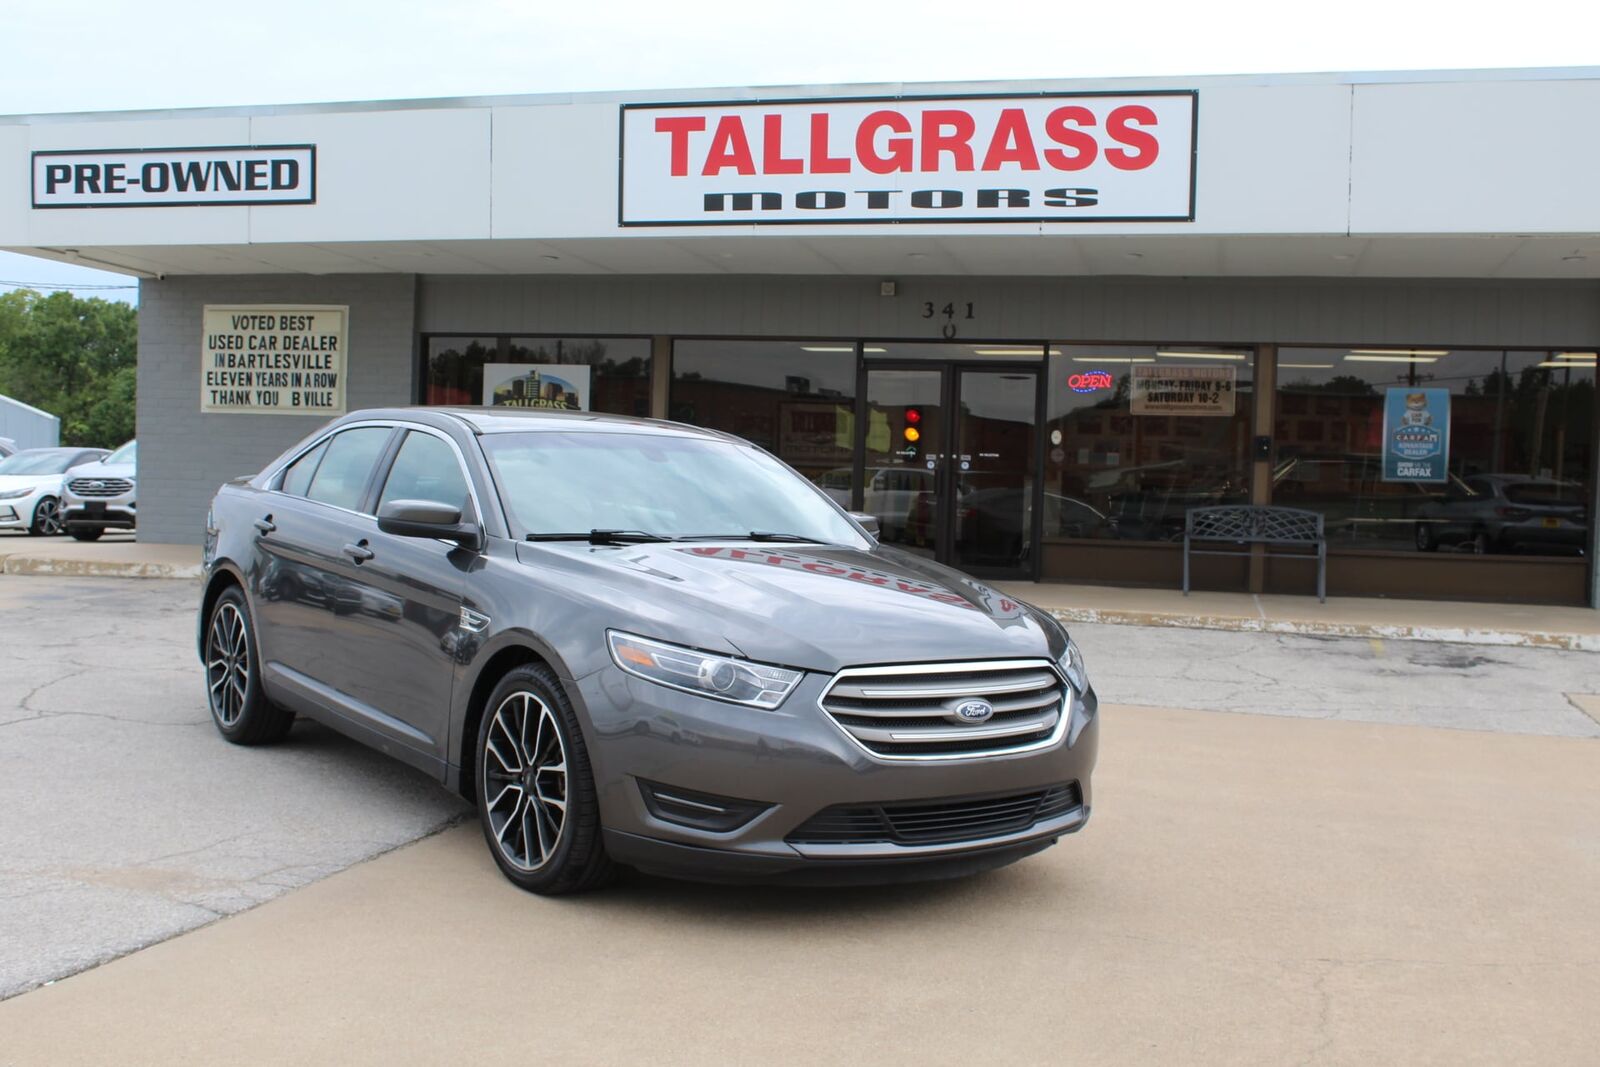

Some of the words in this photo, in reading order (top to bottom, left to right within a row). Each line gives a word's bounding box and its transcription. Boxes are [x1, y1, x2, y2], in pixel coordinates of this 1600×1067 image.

[654, 104, 1160, 176] TALLGRASS
[45, 158, 299, 194] PRE-OWNED
[232, 315, 275, 331] VOTED
[280, 315, 315, 331] BEST
[209, 335, 243, 350] USED
[248, 335, 277, 350] CAR
[283, 336, 337, 351] DEALER
[215, 353, 225, 367] IN
[228, 354, 332, 369] BARTLESVILLE
[207, 371, 252, 386] ELEVEN
[256, 372, 288, 387] YEARS
[291, 373, 302, 387] IN
[305, 373, 311, 388] A
[314, 373, 337, 388] ROW
[1067, 374, 1112, 389] OPEN
[211, 390, 251, 405] THANK
[256, 390, 279, 406] YOU
[292, 391, 300, 406] B
[304, 391, 333, 407] VILLE
[1147, 392, 1194, 403] SATURDAY
[1397, 468, 1432, 477] CARFAX
[965, 703, 987, 718] Ford
